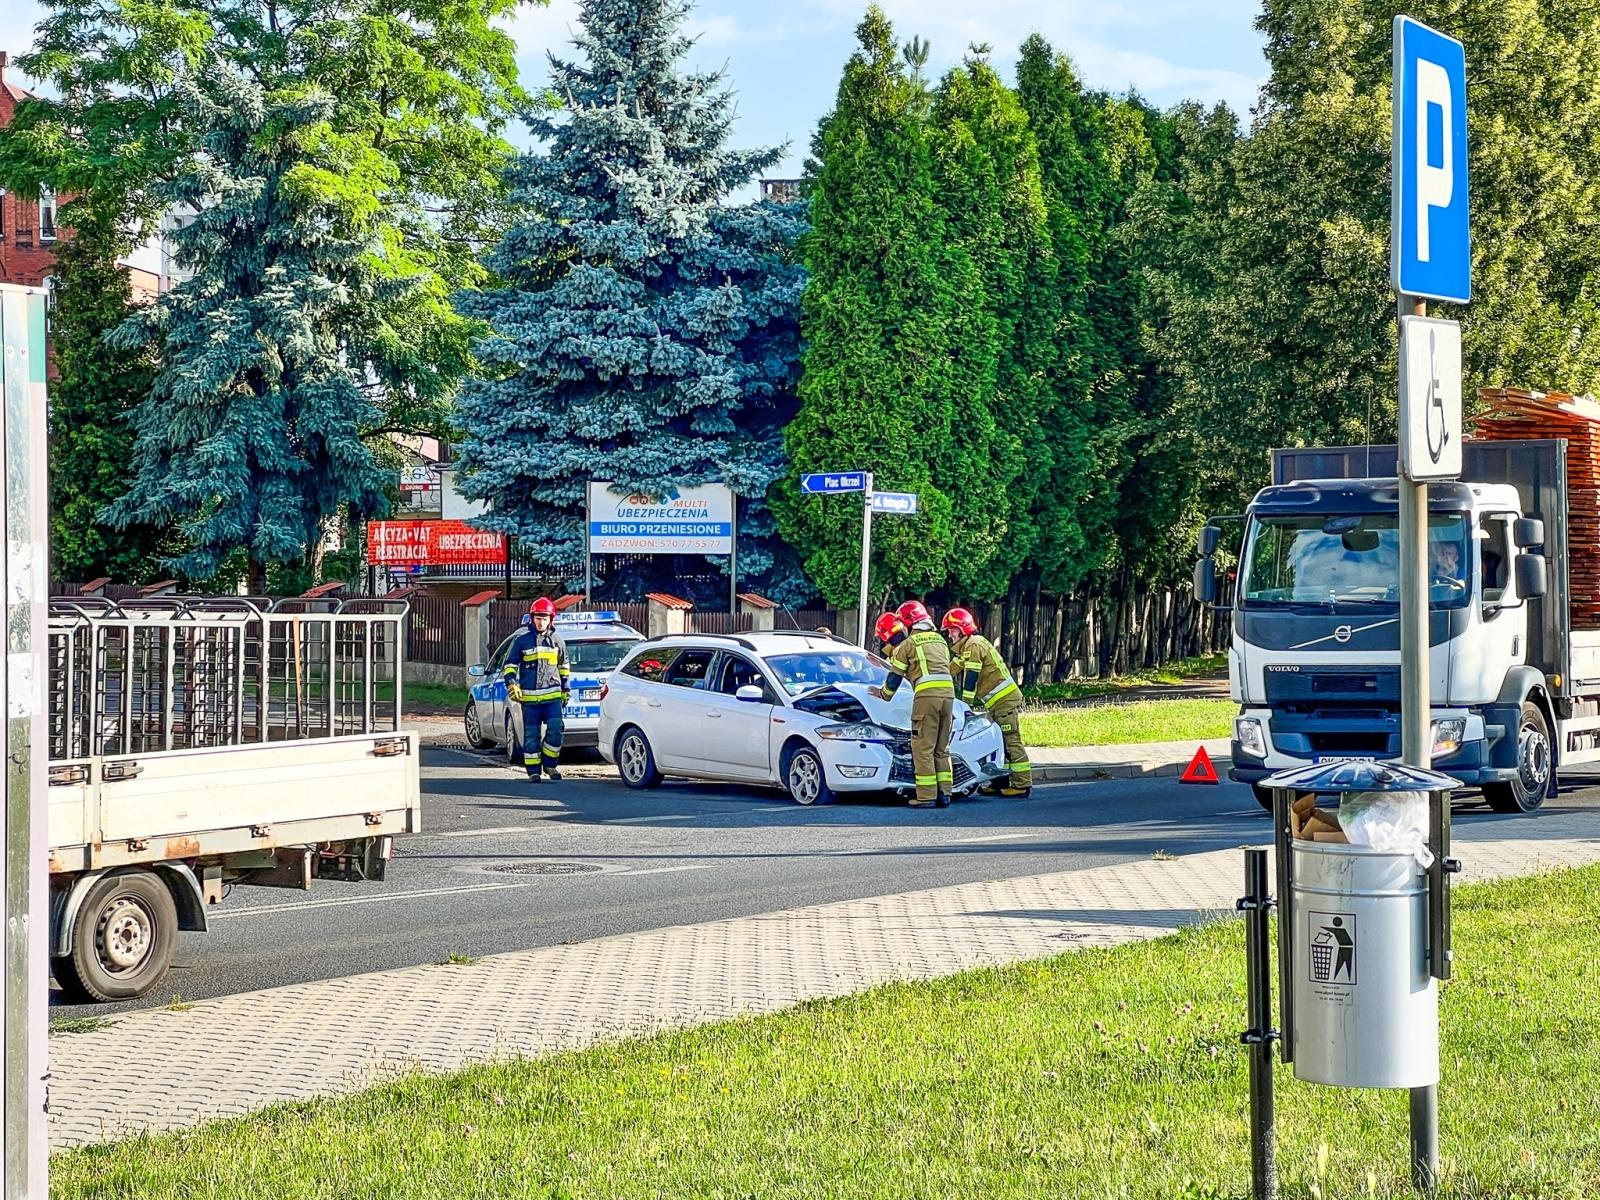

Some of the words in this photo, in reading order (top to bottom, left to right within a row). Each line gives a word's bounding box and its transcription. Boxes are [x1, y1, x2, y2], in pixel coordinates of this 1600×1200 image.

[1417, 57, 1453, 263] P
[824, 477, 839, 488] Plac
[673, 500, 707, 508] MULTI
[617, 508, 709, 518] UBEZPIECZENIA
[601, 524, 637, 534] BIURO
[639, 524, 721, 534] PRZENIESIONE
[373, 527, 408, 542] ACYZA
[439, 533, 502, 549] UBEZPIECZENIA
[660, 540, 678, 548] 570
[679, 540, 694, 548] 77
[695, 540, 707, 548] 55
[708, 540, 721, 548] 77
[562, 613, 593, 621] POLICJA
[561, 706, 587, 715] OLICJA
